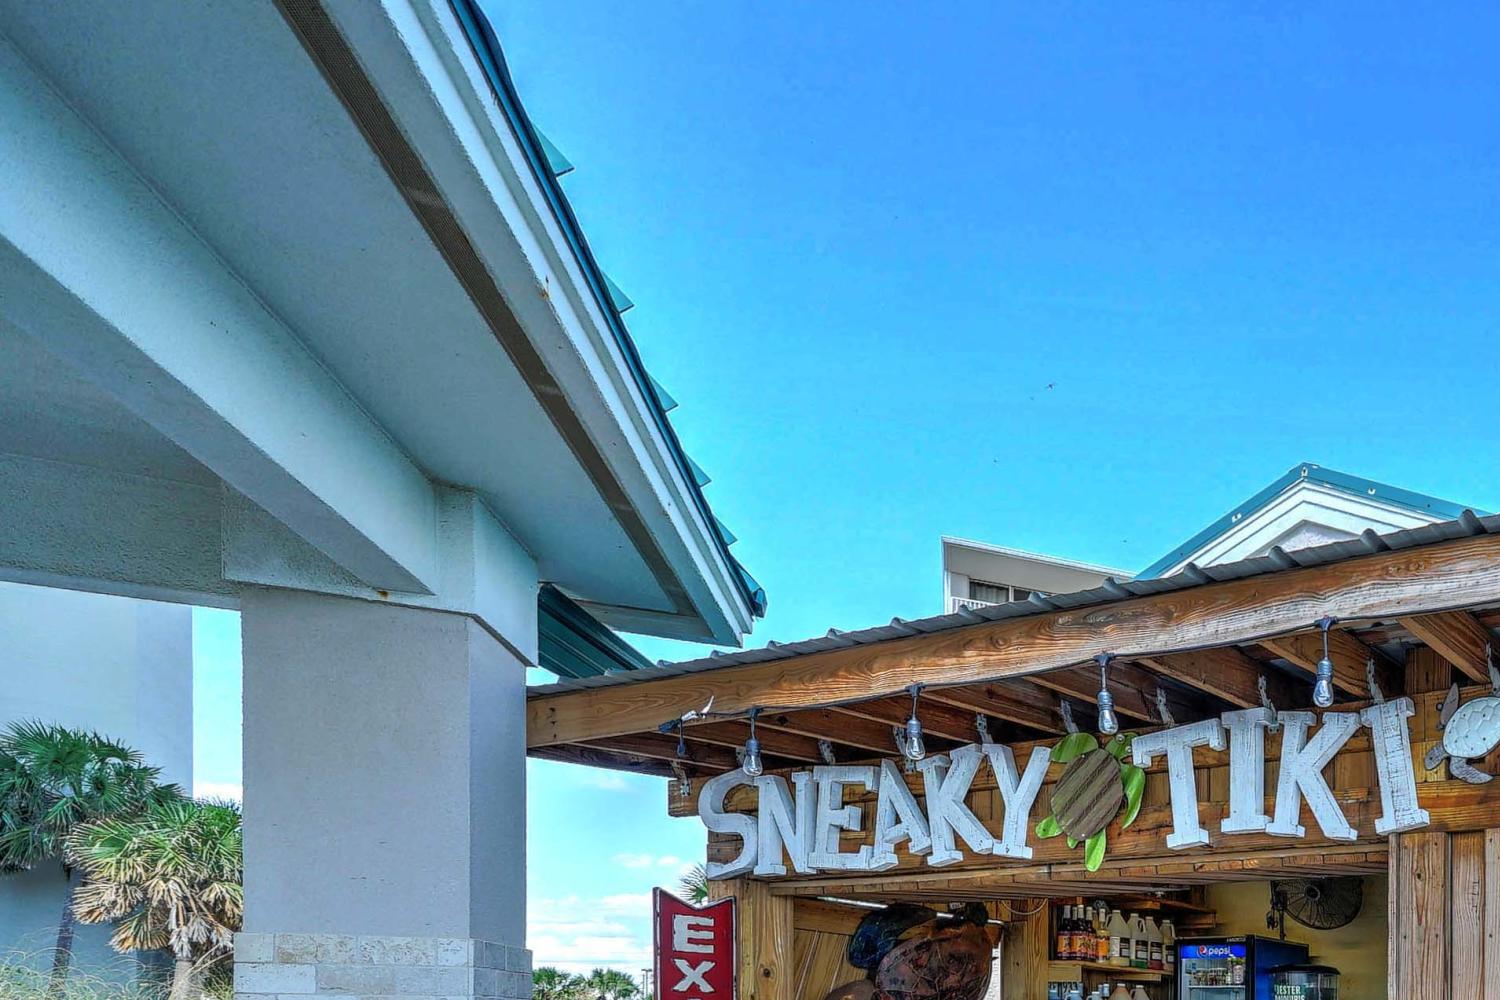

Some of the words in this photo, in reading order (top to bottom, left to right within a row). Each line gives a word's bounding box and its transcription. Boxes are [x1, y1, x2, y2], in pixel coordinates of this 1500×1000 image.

[698, 743, 1052, 880] SNEAKY
[1131, 697, 1430, 850] TIKI
[1208, 945, 1231, 956] pepsi
